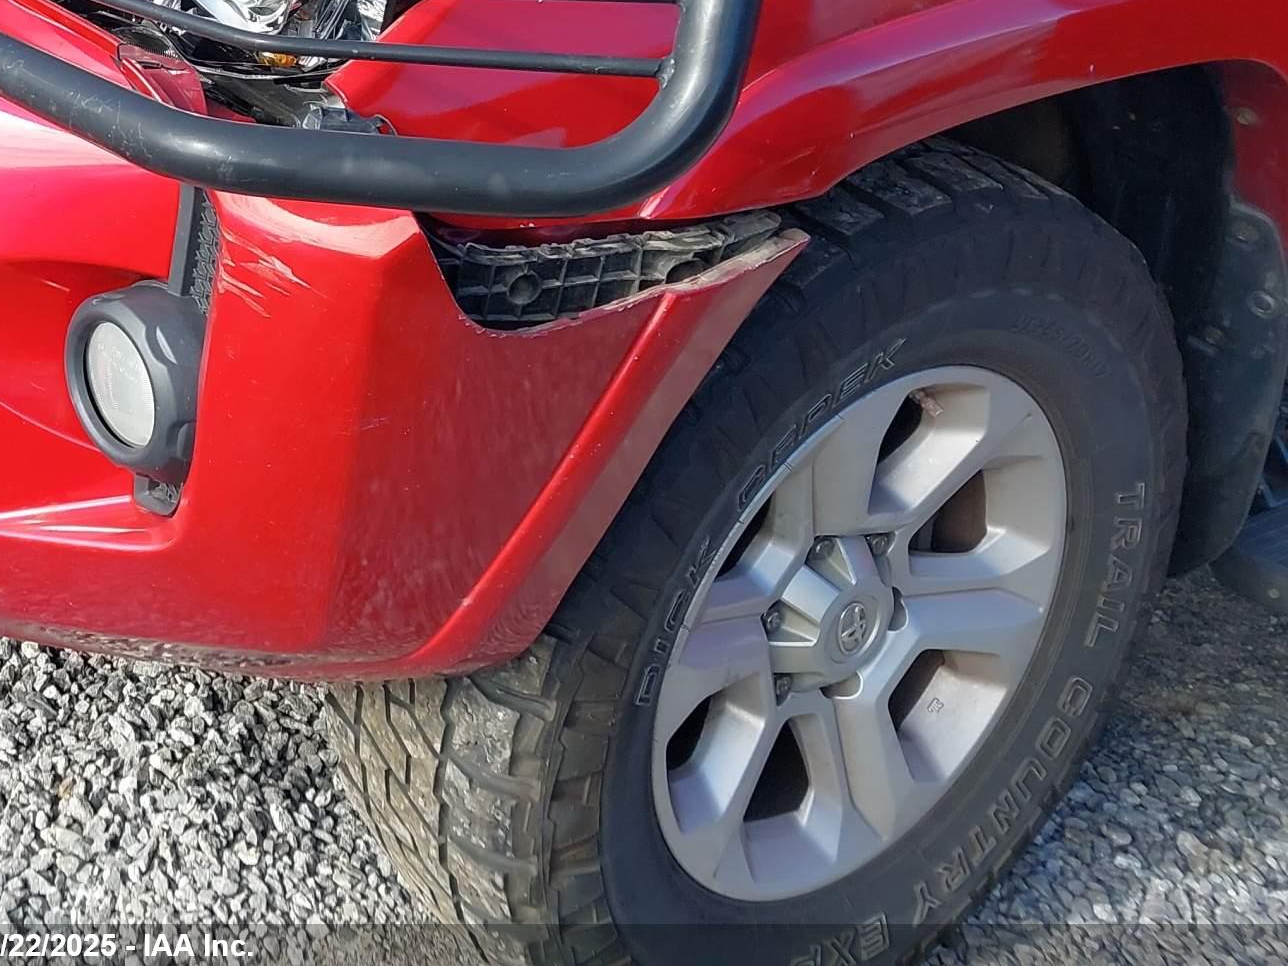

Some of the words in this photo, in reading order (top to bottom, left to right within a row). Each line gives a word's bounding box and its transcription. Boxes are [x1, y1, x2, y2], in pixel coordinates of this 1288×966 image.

[635, 535, 718, 706] DICK
[737, 337, 908, 512] CEPEK
[1084, 481, 1146, 648] TRAIL
[913, 676, 1094, 927] COUNTRY
